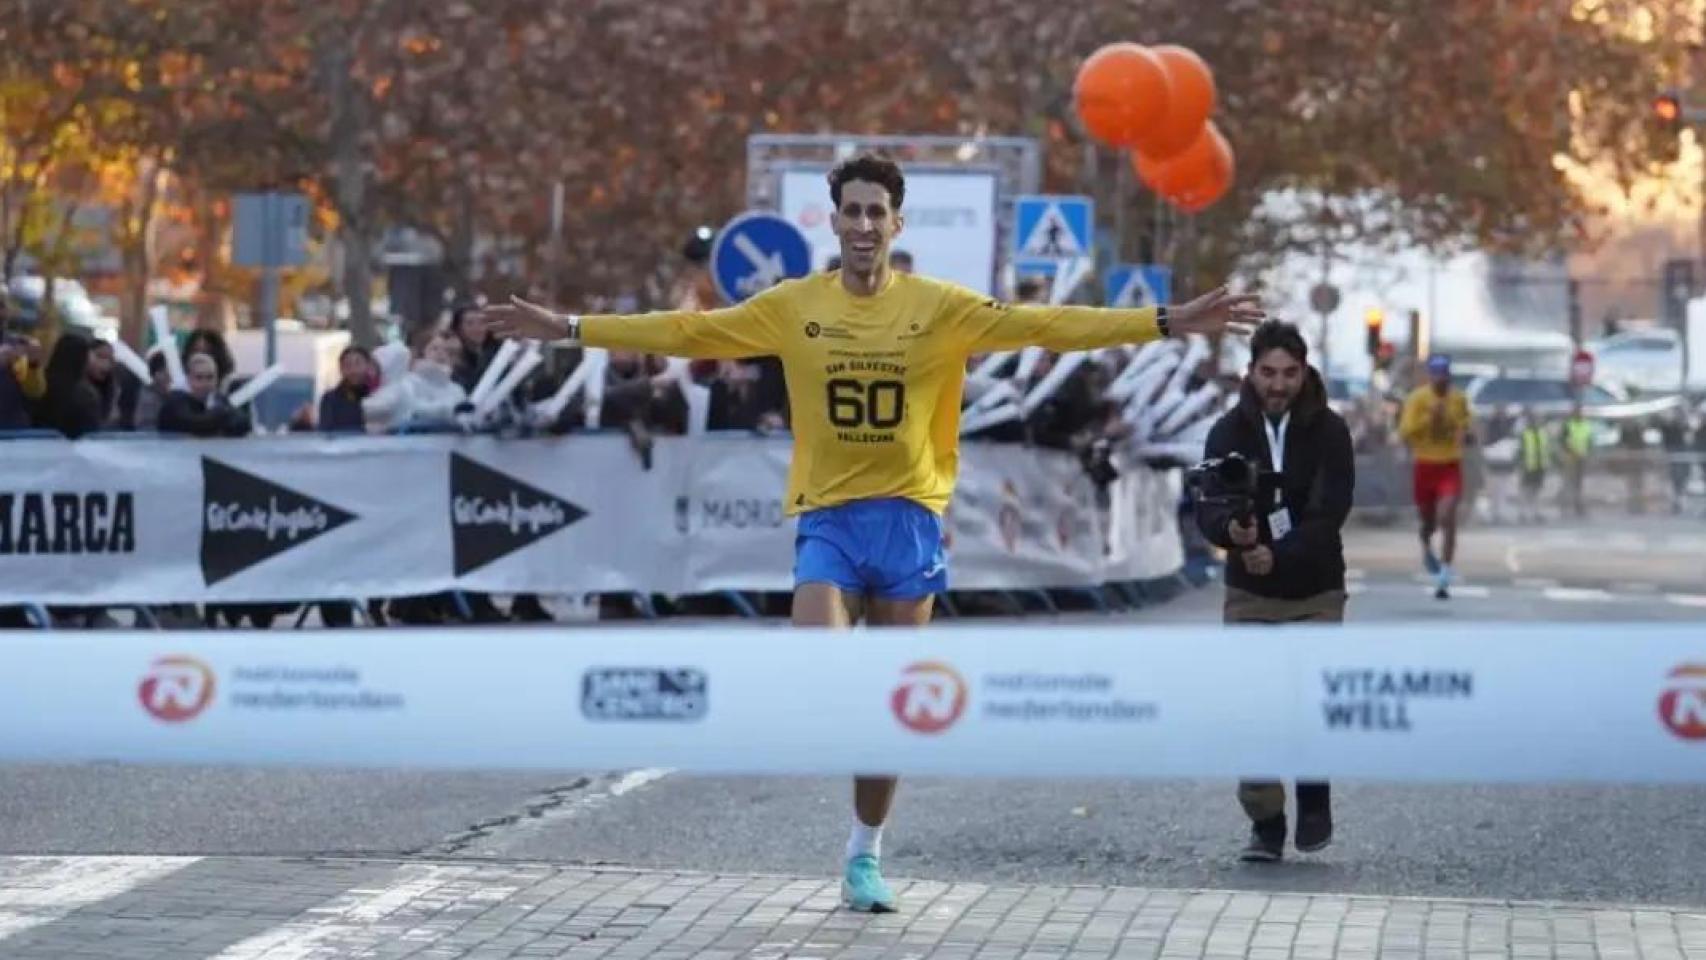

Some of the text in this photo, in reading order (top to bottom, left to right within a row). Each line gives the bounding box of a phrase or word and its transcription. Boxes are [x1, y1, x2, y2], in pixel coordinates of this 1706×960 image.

[827, 378, 905, 429] 60
[1322, 670, 1474, 697] VITAMIN
[1323, 703, 1412, 731] WELL
